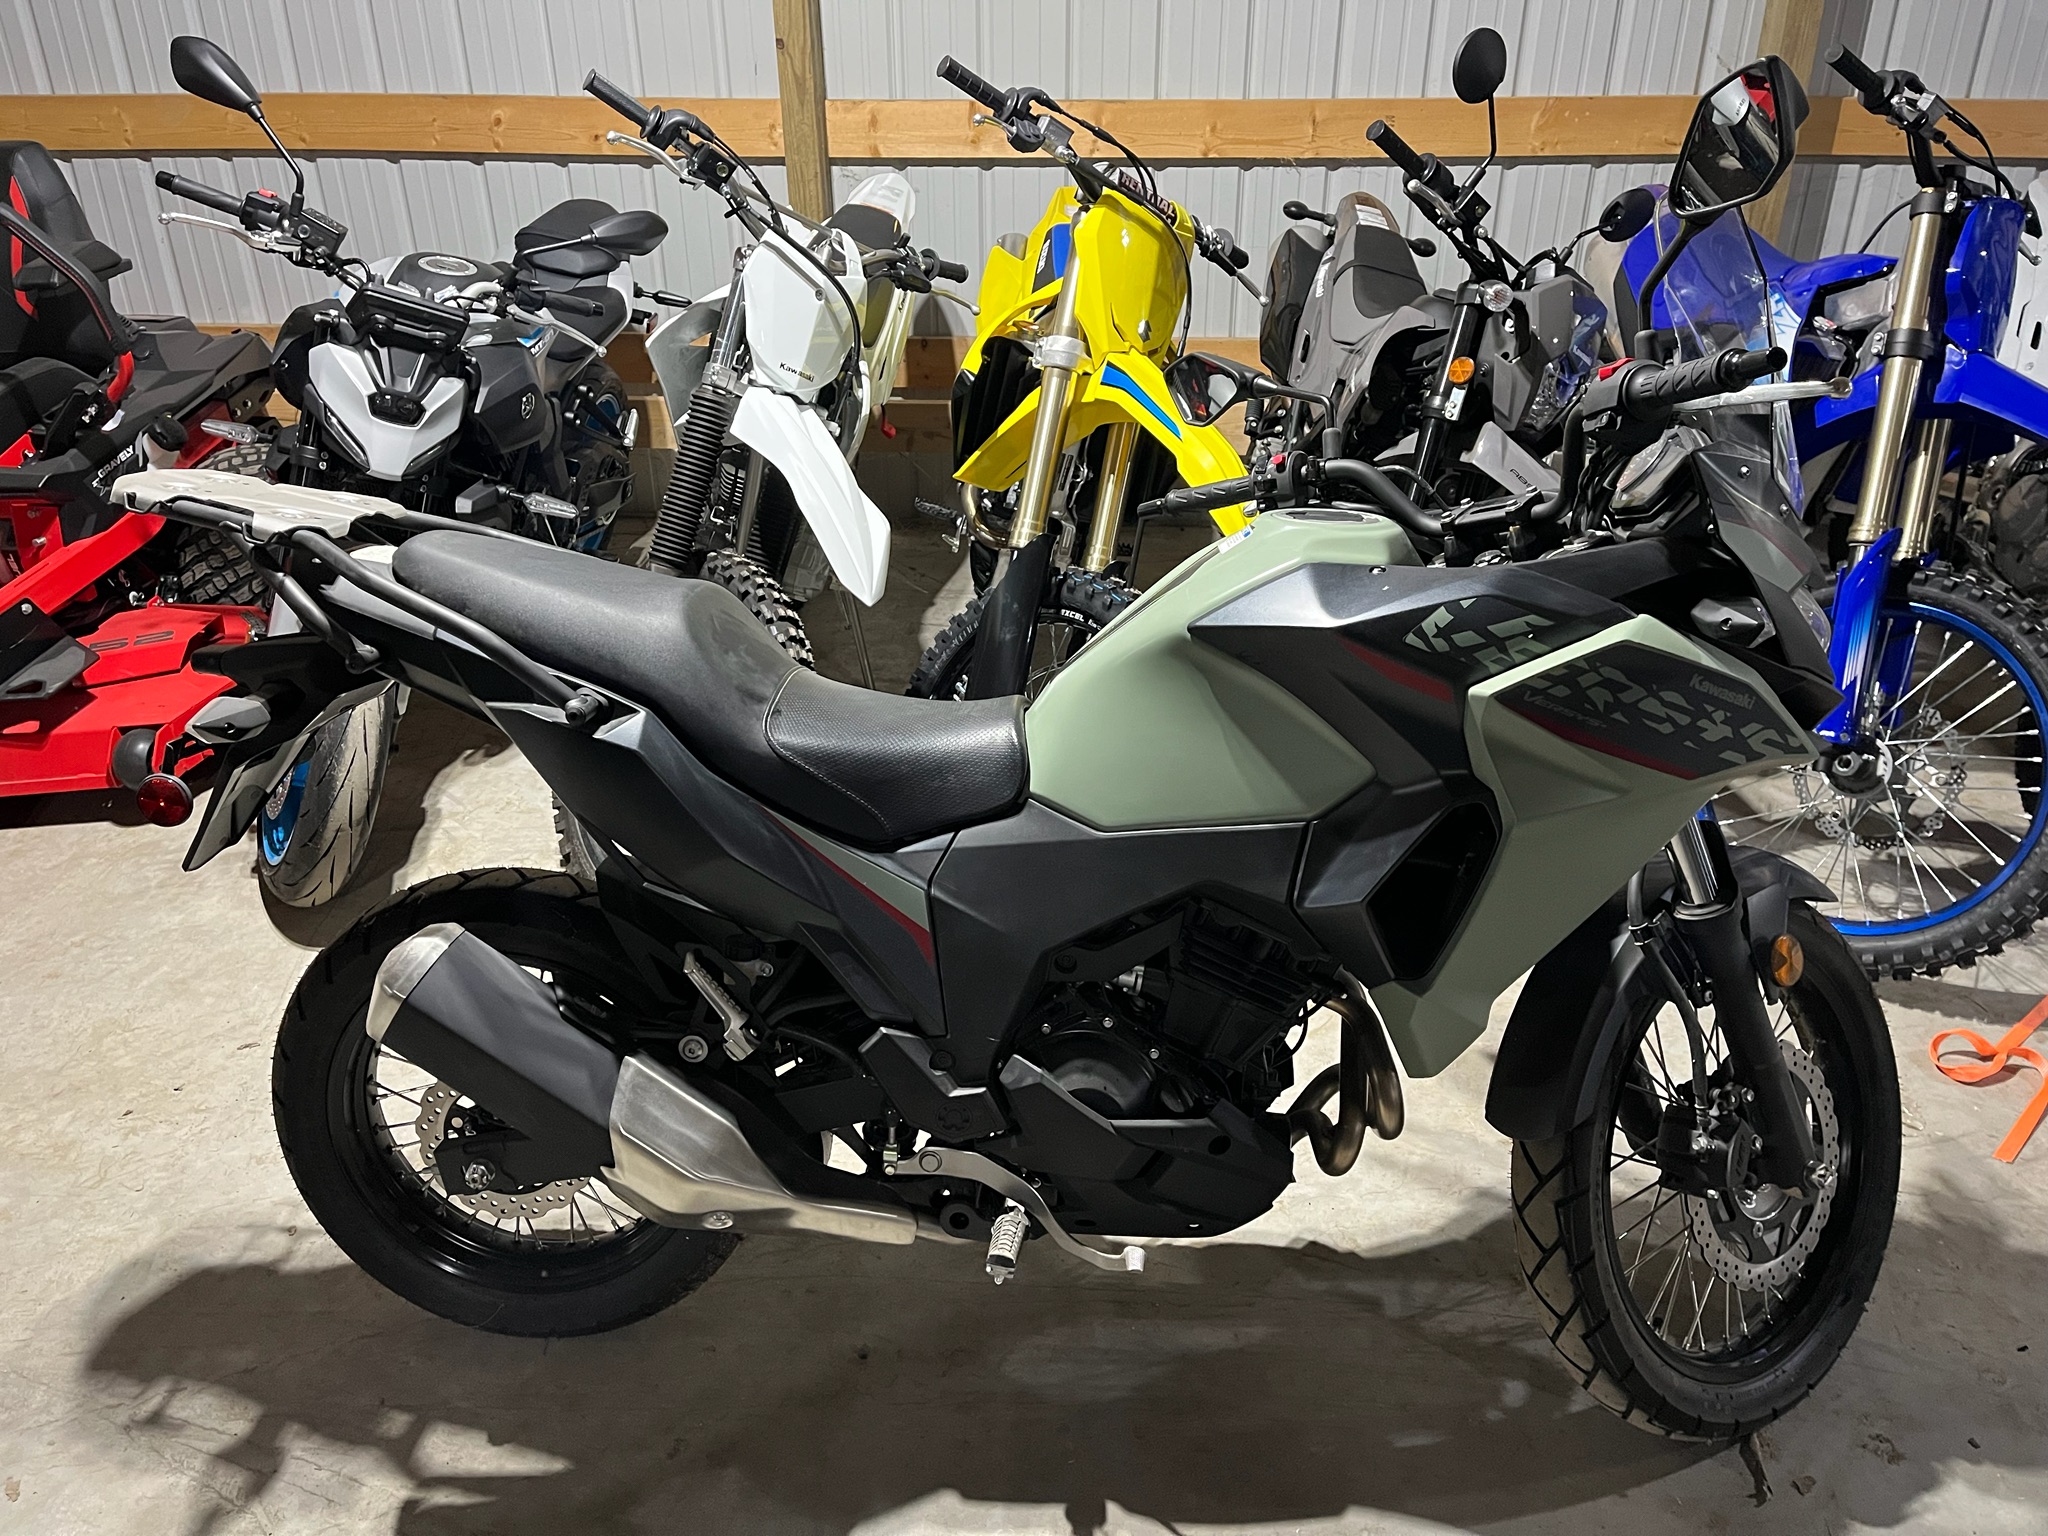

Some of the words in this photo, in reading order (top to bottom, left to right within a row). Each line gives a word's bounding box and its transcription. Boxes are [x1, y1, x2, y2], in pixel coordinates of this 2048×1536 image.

[779, 361, 815, 383] Kawasaki
[97, 444, 134, 479] GRAVELY
[89, 630, 174, 652] 52
[1689, 673, 1756, 711] Kawasaki
